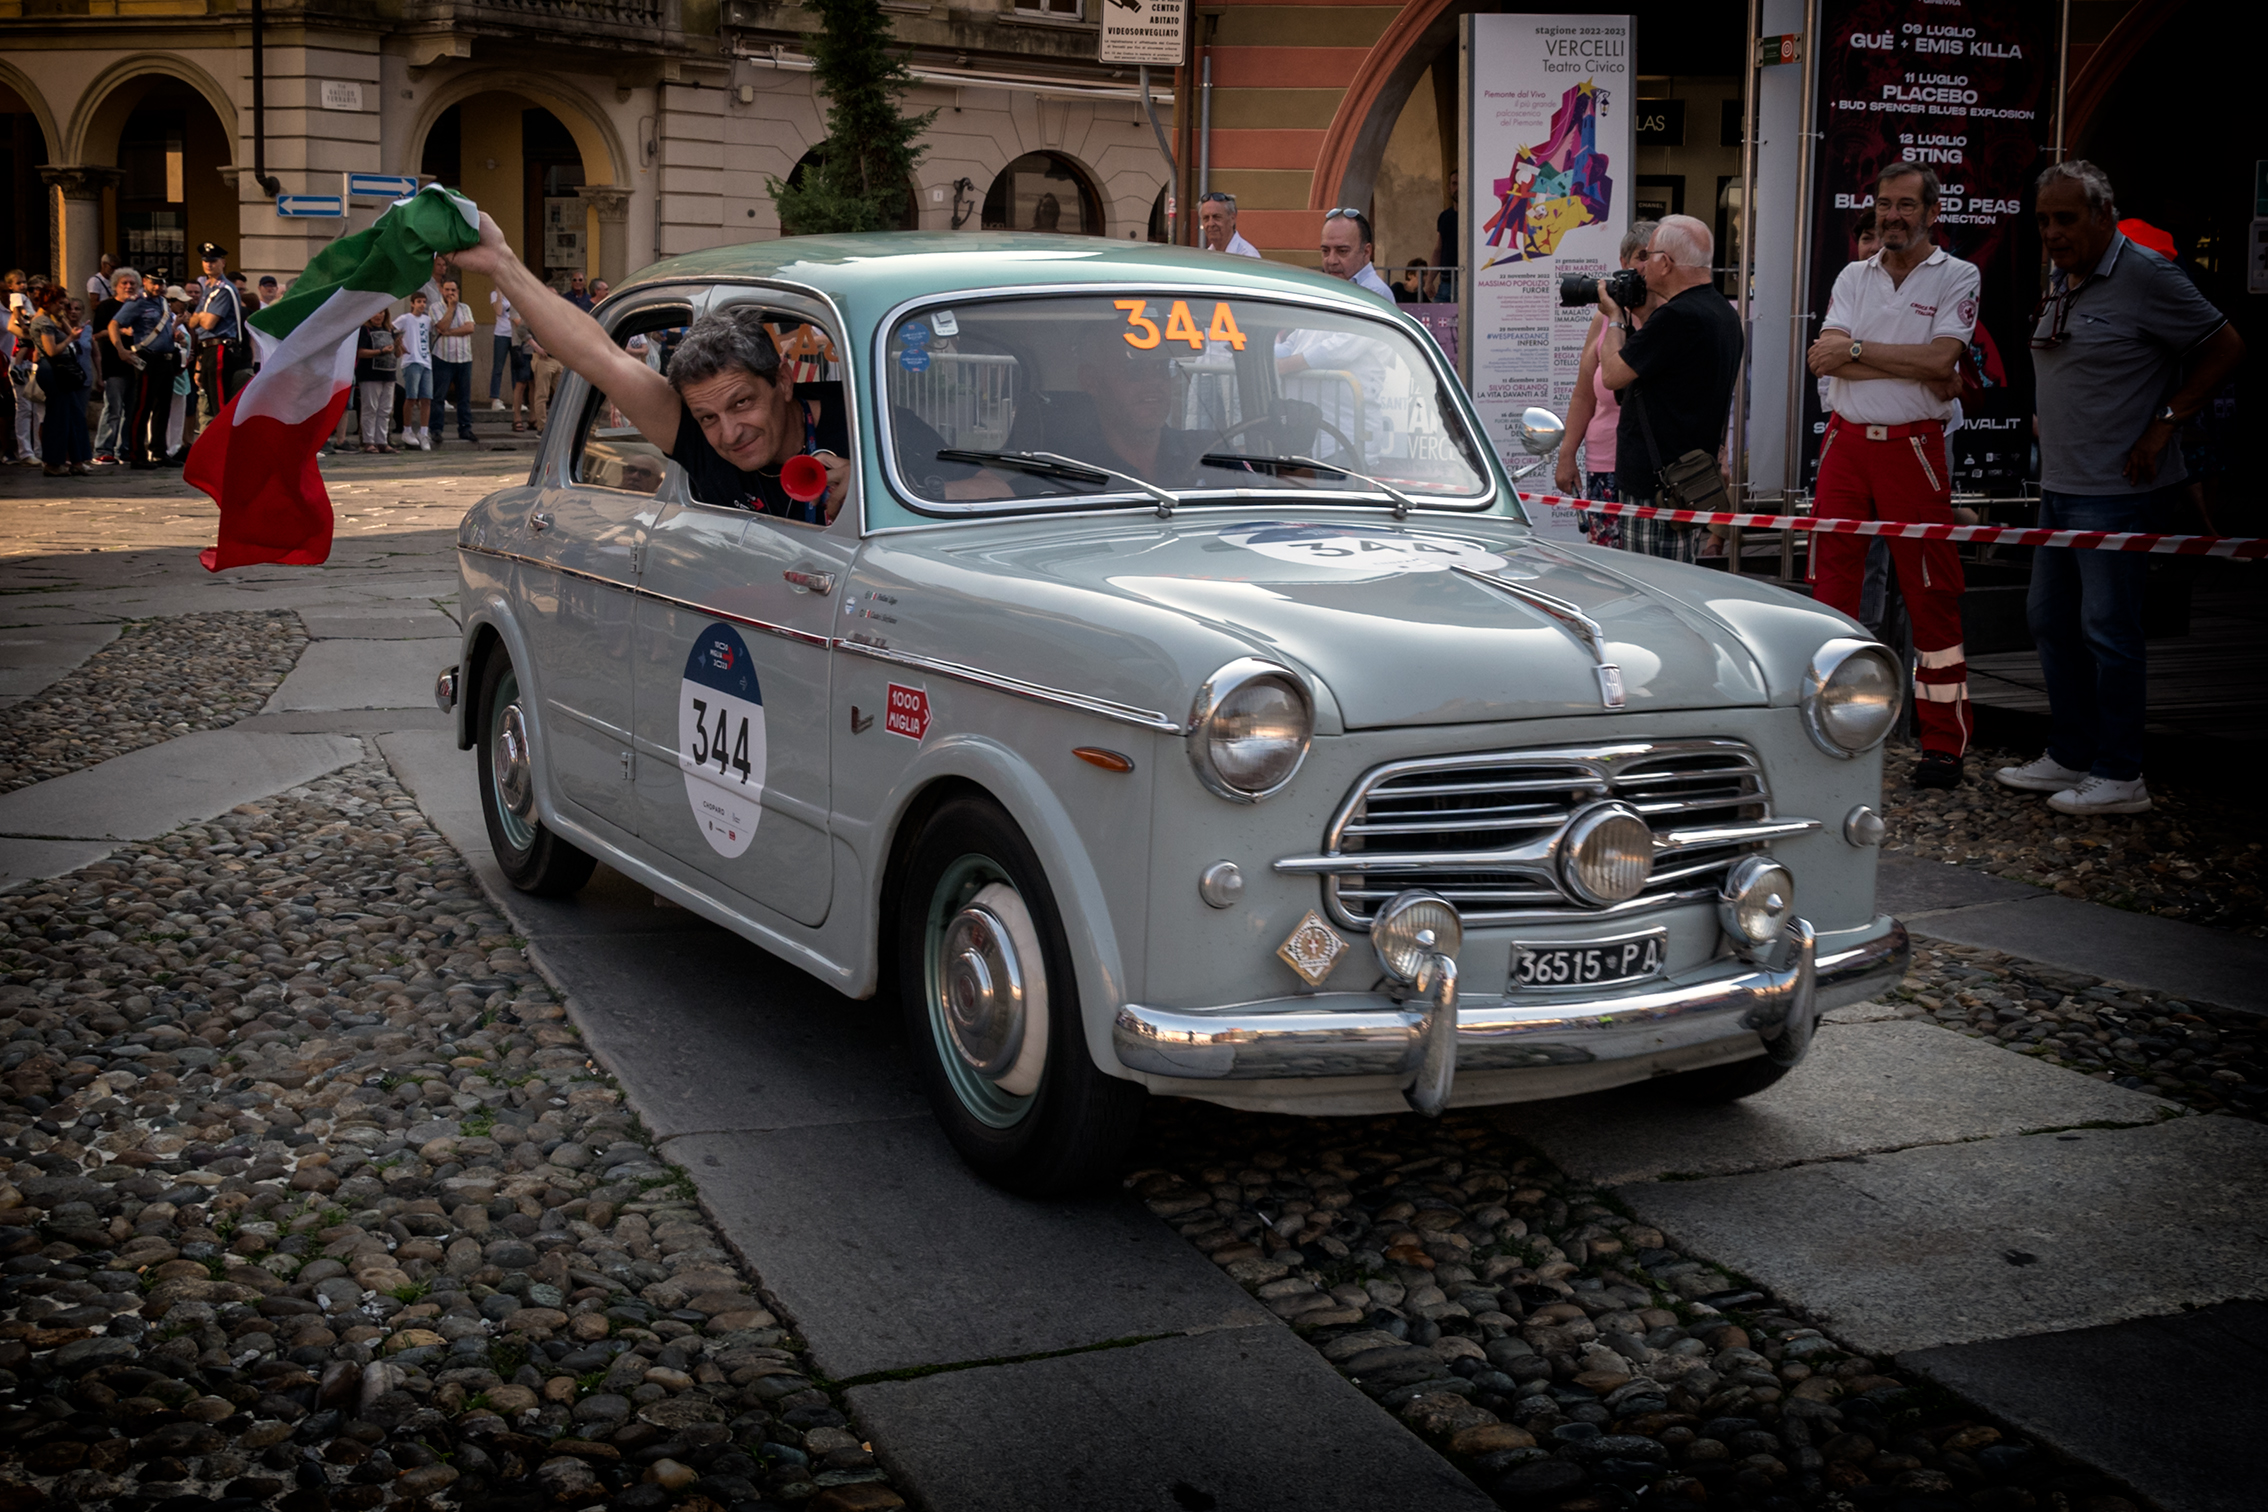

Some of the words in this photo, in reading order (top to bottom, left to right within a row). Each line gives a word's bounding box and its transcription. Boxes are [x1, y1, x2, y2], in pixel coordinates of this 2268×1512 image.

[1152, 4, 1180, 12] CENTRO
[1150, 16, 1180, 24] ABITATO
[1108, 27, 1179, 37] VIDEOSORVEGLIATO
[1536, 26, 1576, 37] stagione
[1580, 27, 1626, 36] 2022-2023
[1902, 22, 1923, 34] 09
[1926, 24, 1976, 38] LUGLIO
[1546, 40, 1624, 57] VERCELLI
[1850, 29, 1894, 50] GUÈ
[1915, 38, 1964, 55] EMIS
[1970, 42, 2023, 59] KILLA
[1542, 60, 1581, 73] Teatro
[1585, 60, 1625, 73] Civico
[1904, 72, 1915, 84] 11
[1918, 73, 1968, 87] LUGLIO
[1484, 90, 1516, 98] Piemonte
[1517, 90, 1529, 98] dal
[1882, 85, 1978, 104] PLACEBO
[1532, 101, 1557, 110] grande
[1838, 100, 1866, 110] BUD
[1869, 101, 1926, 114] SPENCER
[1928, 105, 1967, 117] BLUES
[1970, 107, 2035, 120] EXPLOSION
[1496, 110, 1541, 119] palcoscenico
[1636, 114, 1666, 132] LAS
[1898, 134, 1914, 144] 12
[1918, 134, 1968, 148] LUGLIO
[1902, 147, 1963, 164] STING
[1834, 193, 1875, 210] BLA
[1940, 196, 1963, 212] ED
[1968, 198, 2021, 215] PEAS
[1934, 214, 1996, 225] NNECTION
[1113, 300, 1248, 350] 344
[1288, 540, 1462, 557] 344
[892, 690, 920, 712] 1000
[888, 711, 920, 734] MIGLIA
[692, 698, 752, 784] 344
[1519, 951, 1602, 984] 36515
